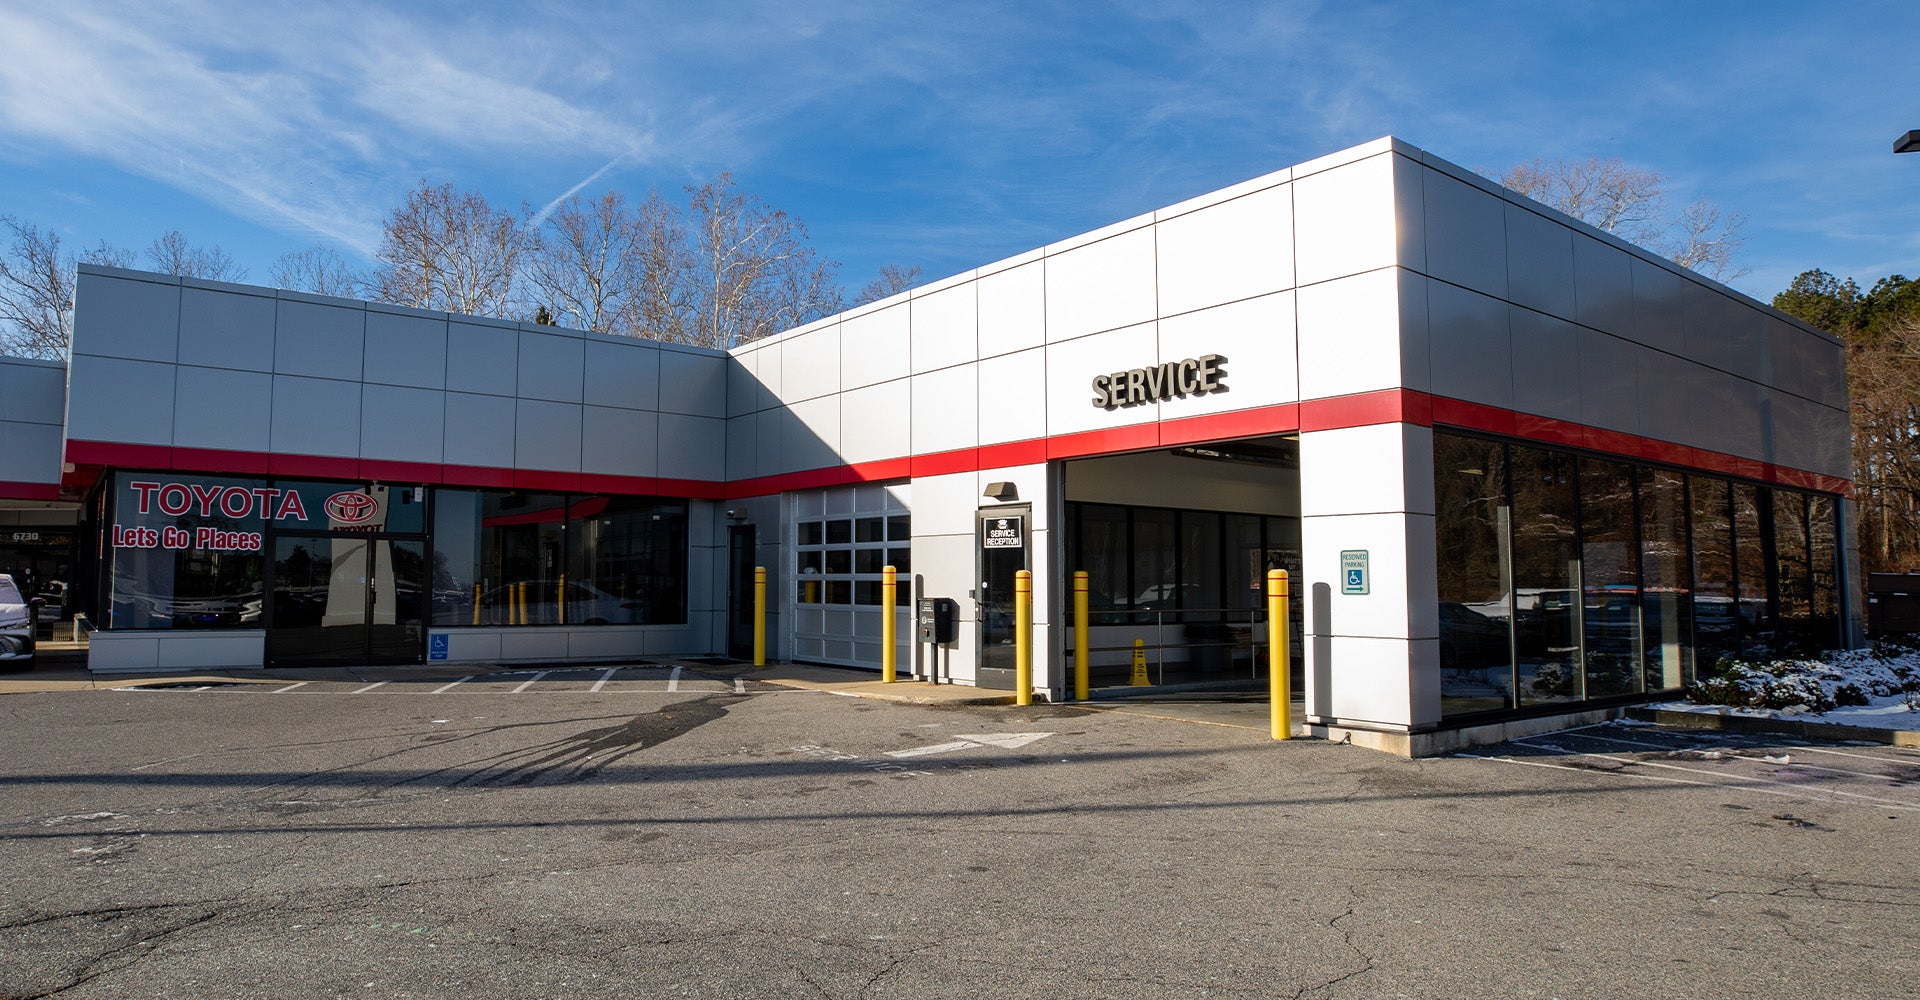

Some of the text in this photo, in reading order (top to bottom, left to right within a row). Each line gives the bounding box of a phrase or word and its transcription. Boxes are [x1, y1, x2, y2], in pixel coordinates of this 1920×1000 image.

[1091, 353, 1226, 411] SERVICE
[130, 481, 308, 521] TOYOTA
[12, 532, 39, 541] 6730
[112, 524, 262, 551] Lets Go Places
[986, 537, 1019, 546] RECEPTION
[990, 529, 1015, 538] SERVICE
